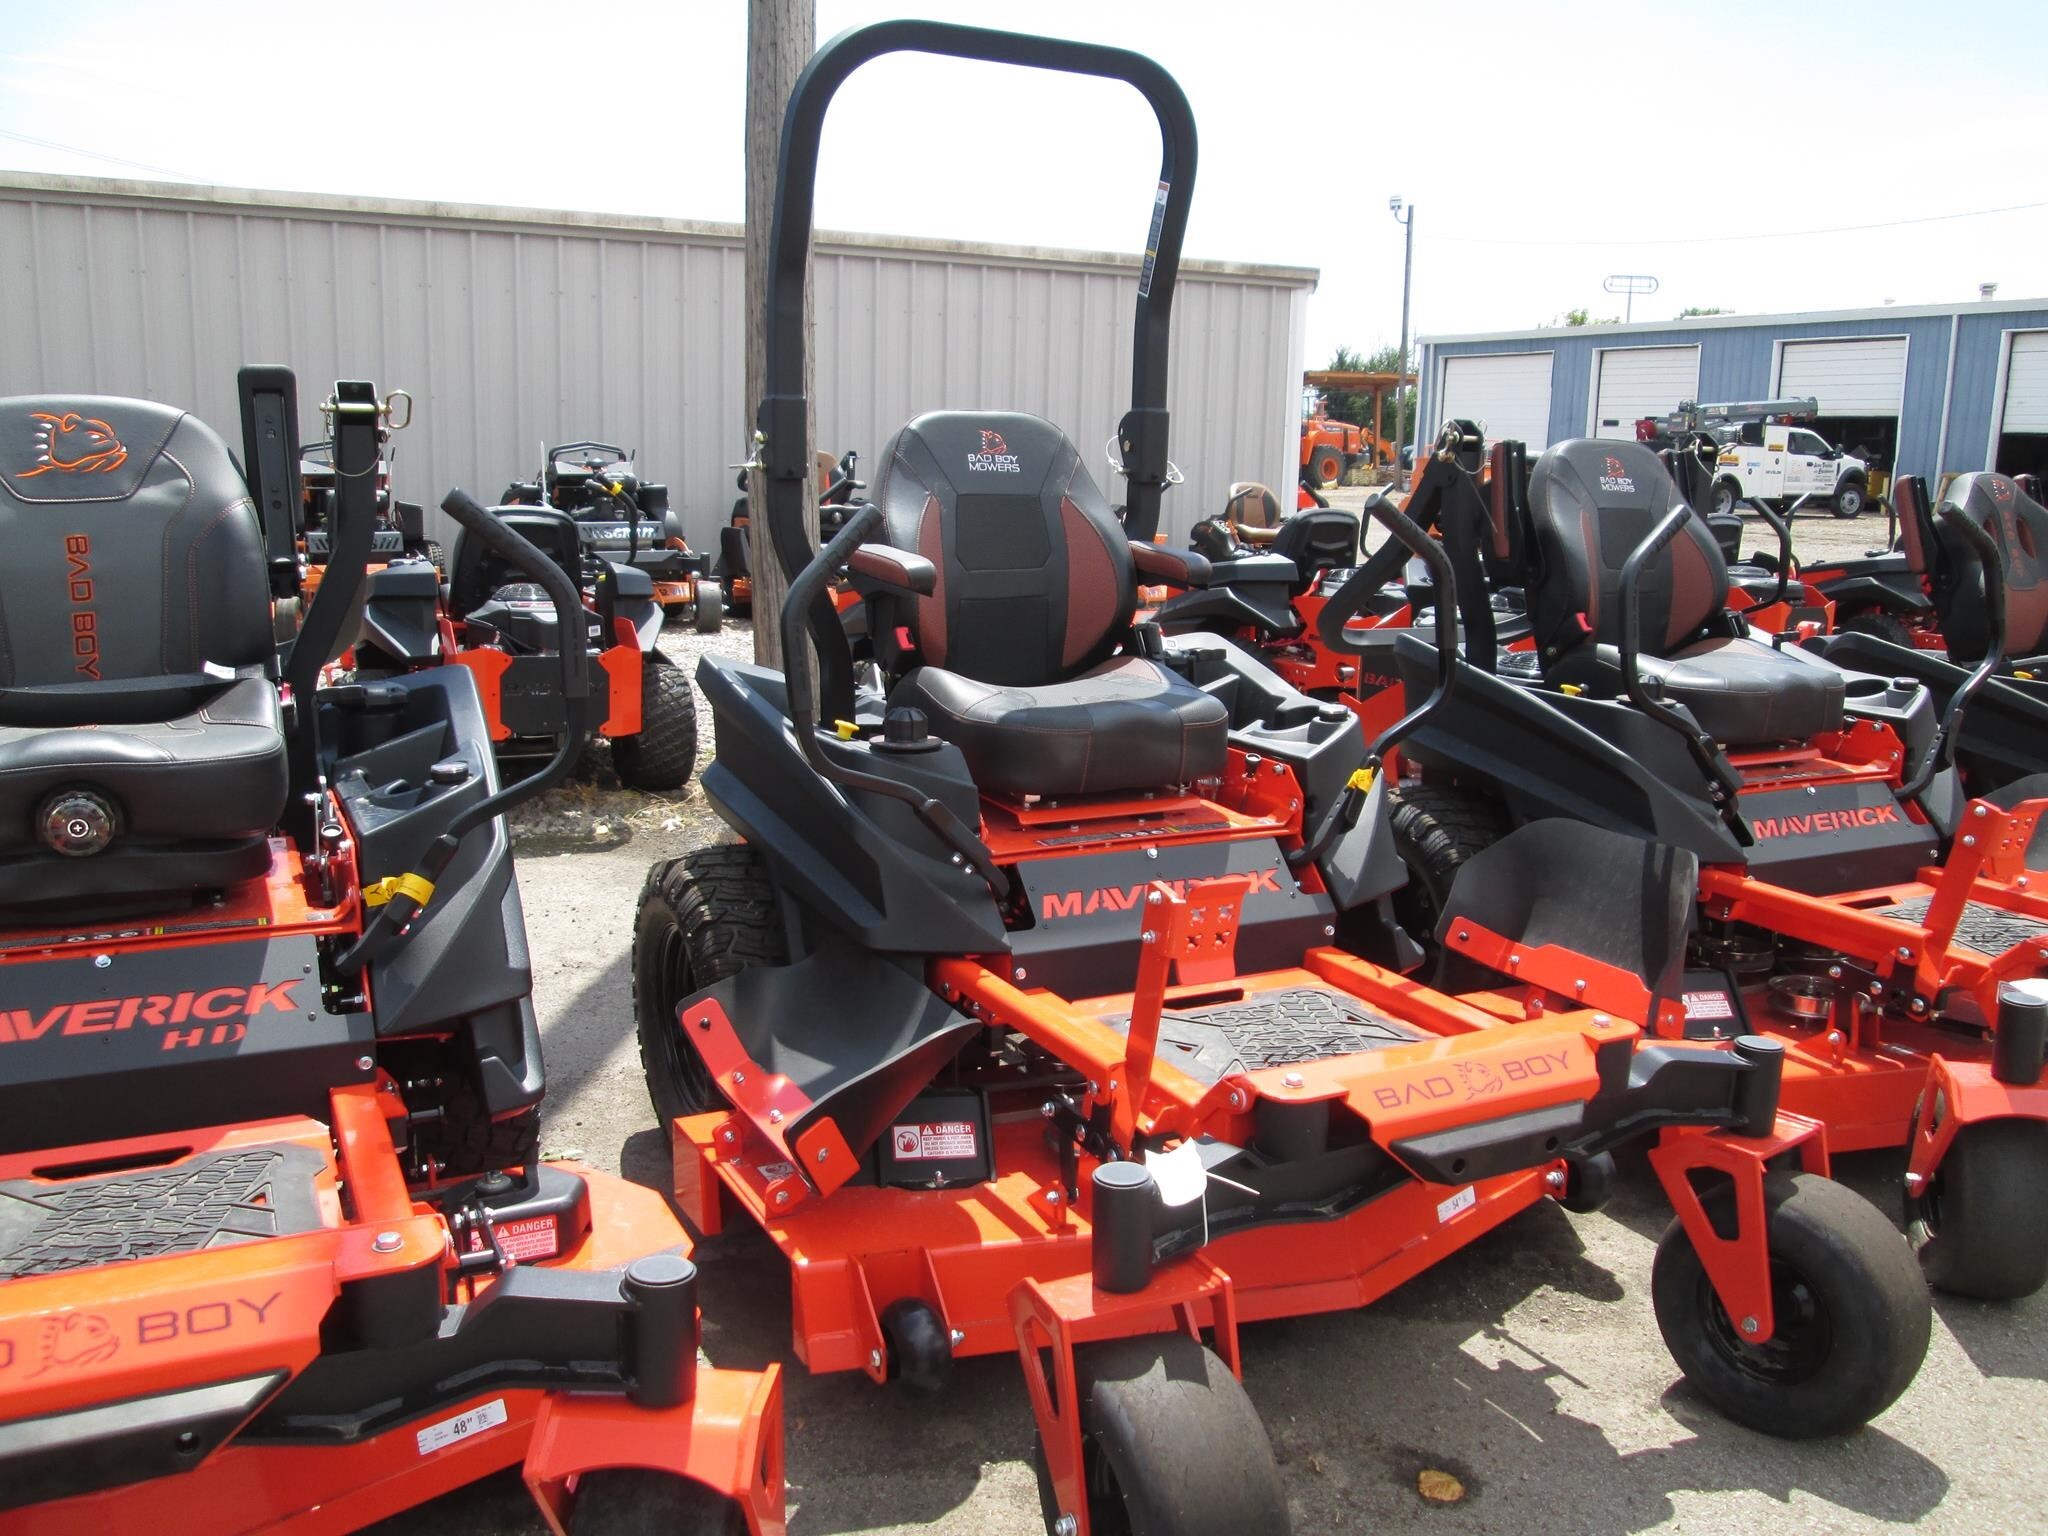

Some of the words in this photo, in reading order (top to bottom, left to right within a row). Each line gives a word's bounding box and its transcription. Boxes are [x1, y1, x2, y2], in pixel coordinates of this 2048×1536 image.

[967, 453, 992, 463] BAD
[994, 454, 1018, 464] BOY
[968, 462, 1021, 473] MOWERS
[1600, 476, 1616, 484] BAD
[1616, 477, 1633, 485] BOY
[1601, 483, 1636, 493] MOWERS
[64, 534, 94, 602] BAD
[72, 611, 101, 681] BOY
[1752, 803, 1900, 840] MAVERICK
[0, 978, 305, 1044] VERICK
[161, 1023, 248, 1051] HD
[1373, 1076, 1454, 1110] BAD
[1502, 1050, 1569, 1082] BOY
[935, 1124, 972, 1134] DANGER
[512, 1218, 553, 1234] DANGER
[138, 1290, 282, 1345] BOY
[453, 1416, 473, 1436] 48"
